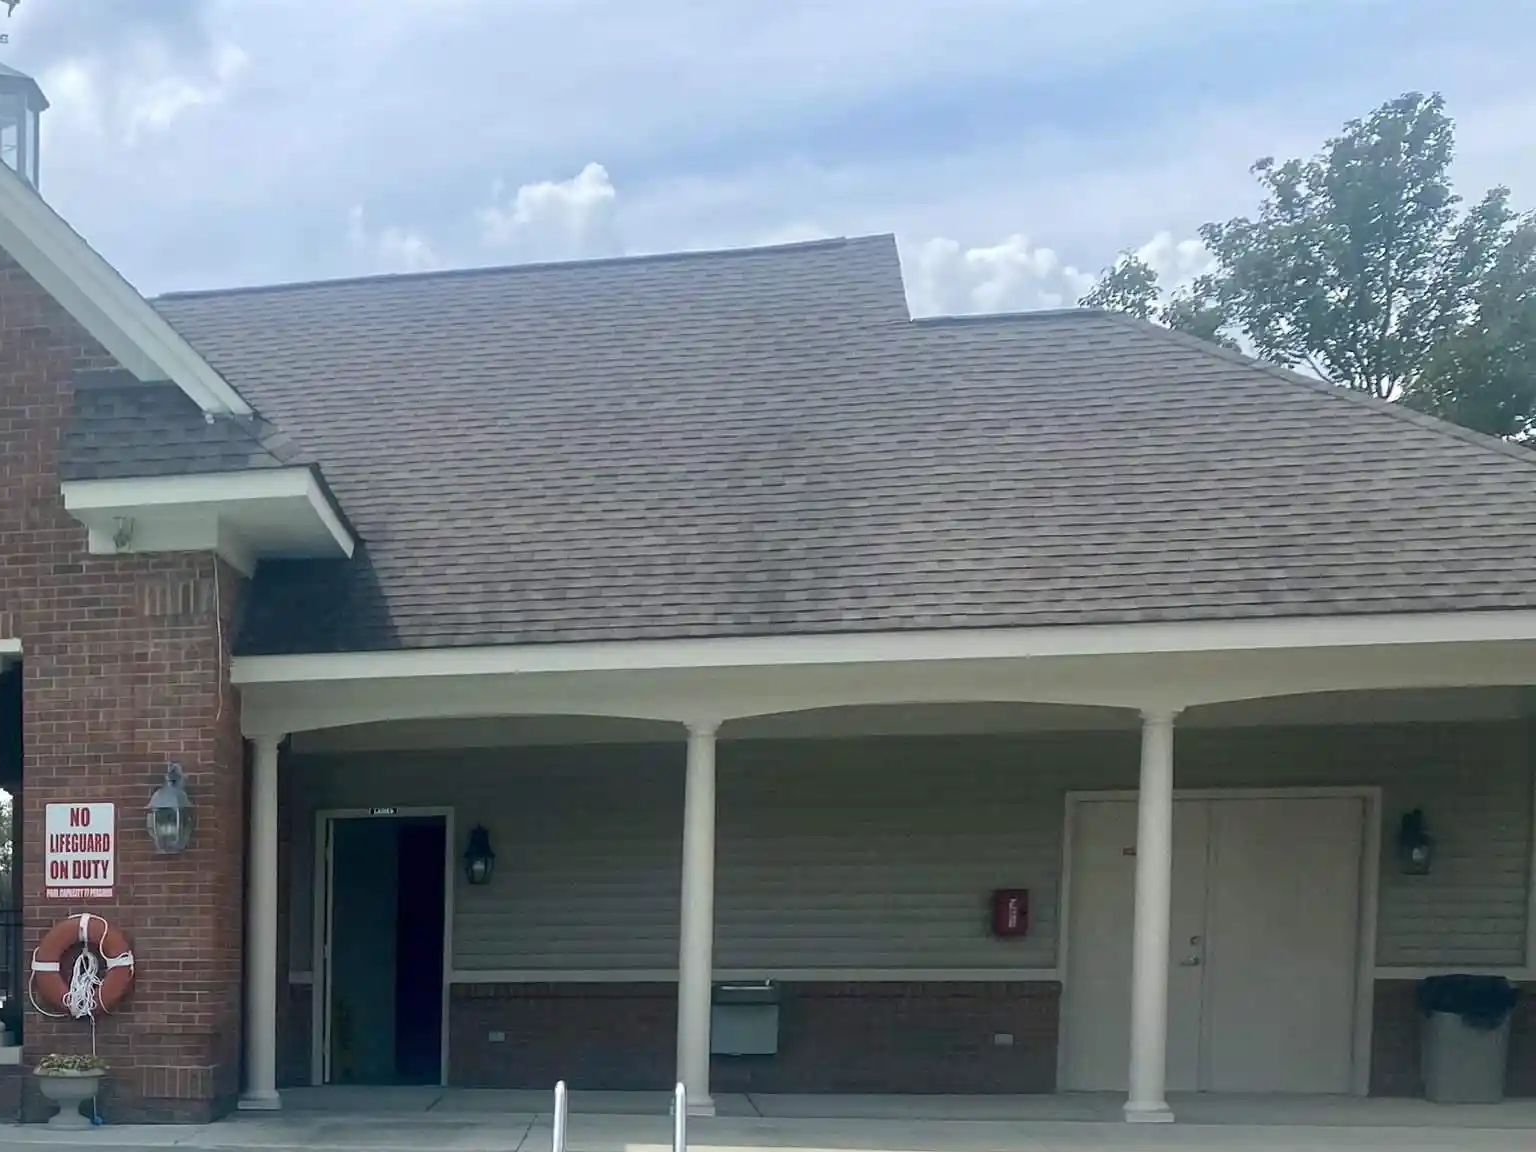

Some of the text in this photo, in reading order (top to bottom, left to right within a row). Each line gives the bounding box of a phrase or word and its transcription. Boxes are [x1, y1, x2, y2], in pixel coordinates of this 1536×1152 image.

[70, 807, 90, 827] NO
[49, 833, 110, 853] LIFEGUARD
[50, 860, 110, 880] ON DUTY
